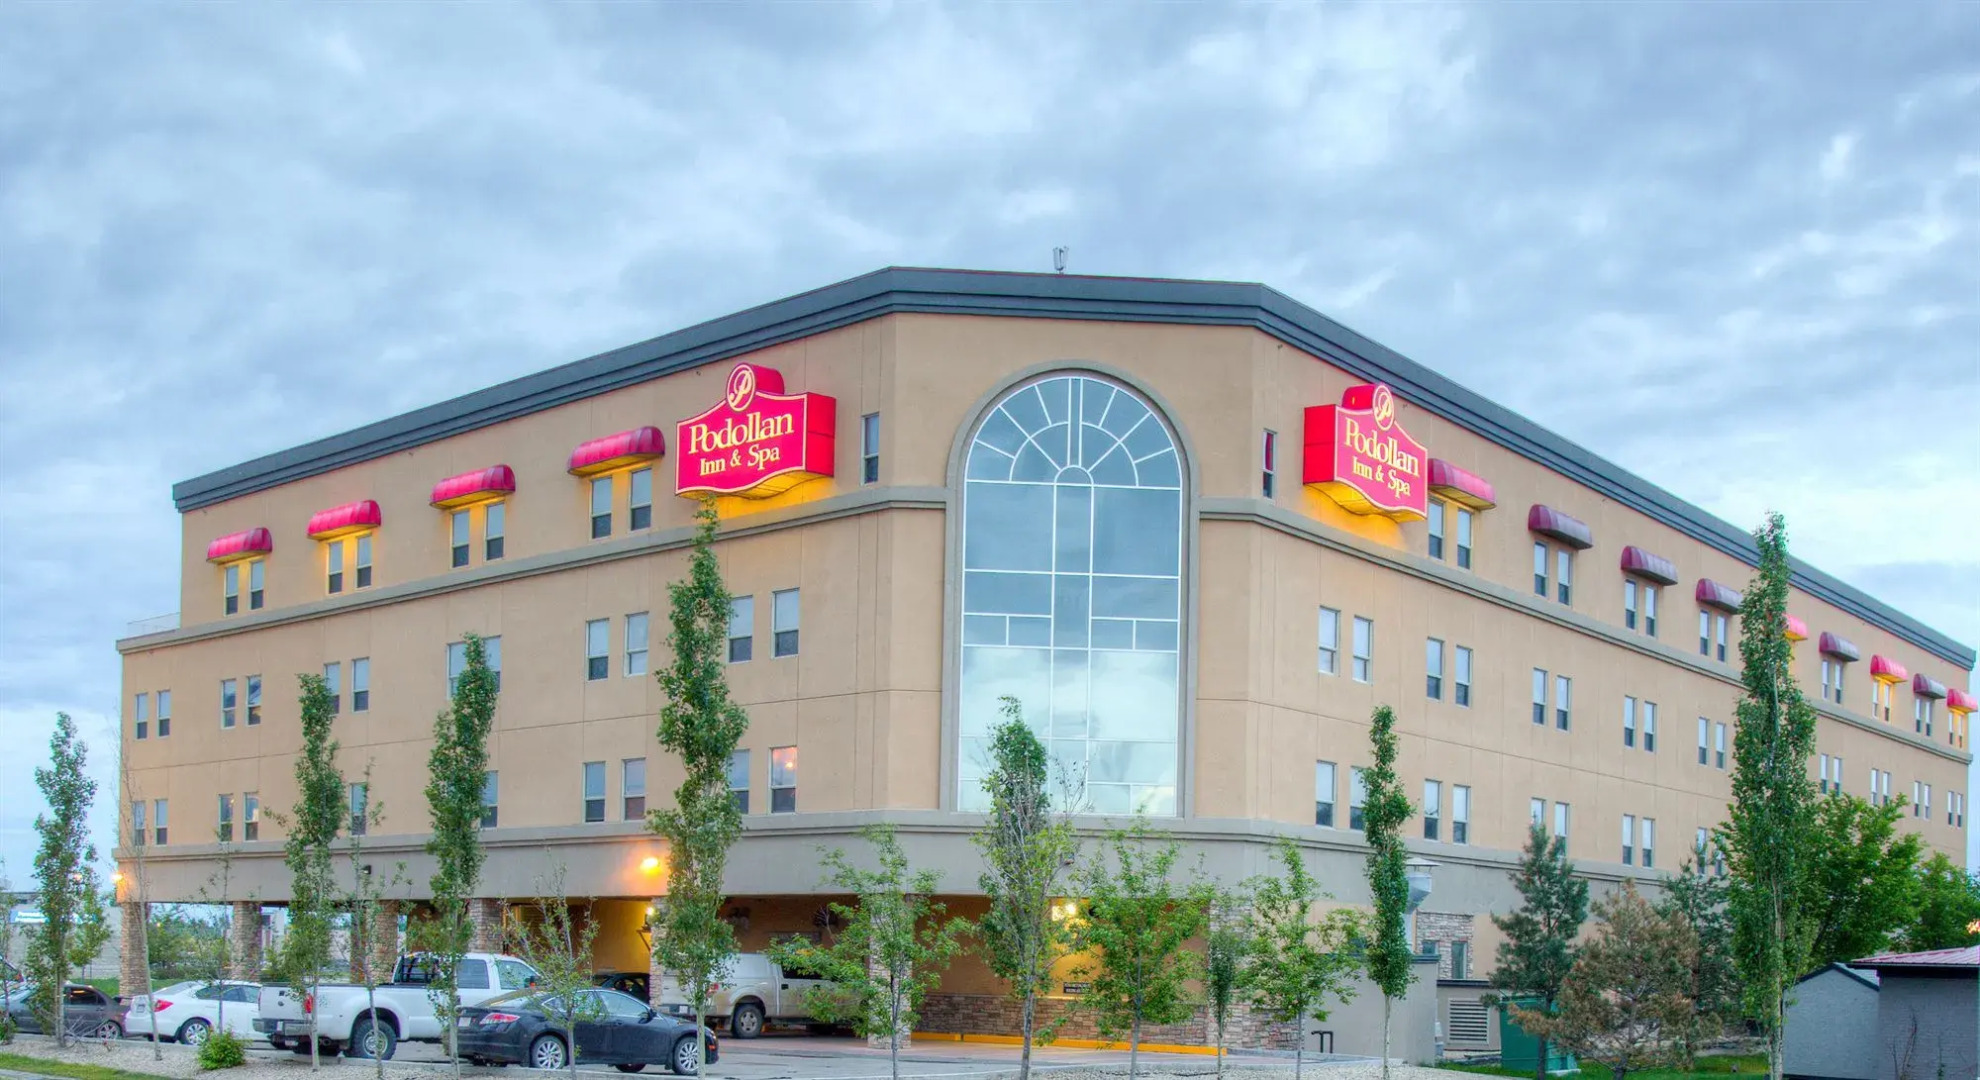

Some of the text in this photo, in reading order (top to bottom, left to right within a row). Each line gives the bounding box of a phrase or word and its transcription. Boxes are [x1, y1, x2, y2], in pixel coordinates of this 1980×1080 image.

[688, 412, 794, 454] Podollan
[1345, 417, 1419, 477] Podollan
[700, 444, 780, 476] Inn & Spa
[1352, 456, 1411, 498] Inn & Spa
